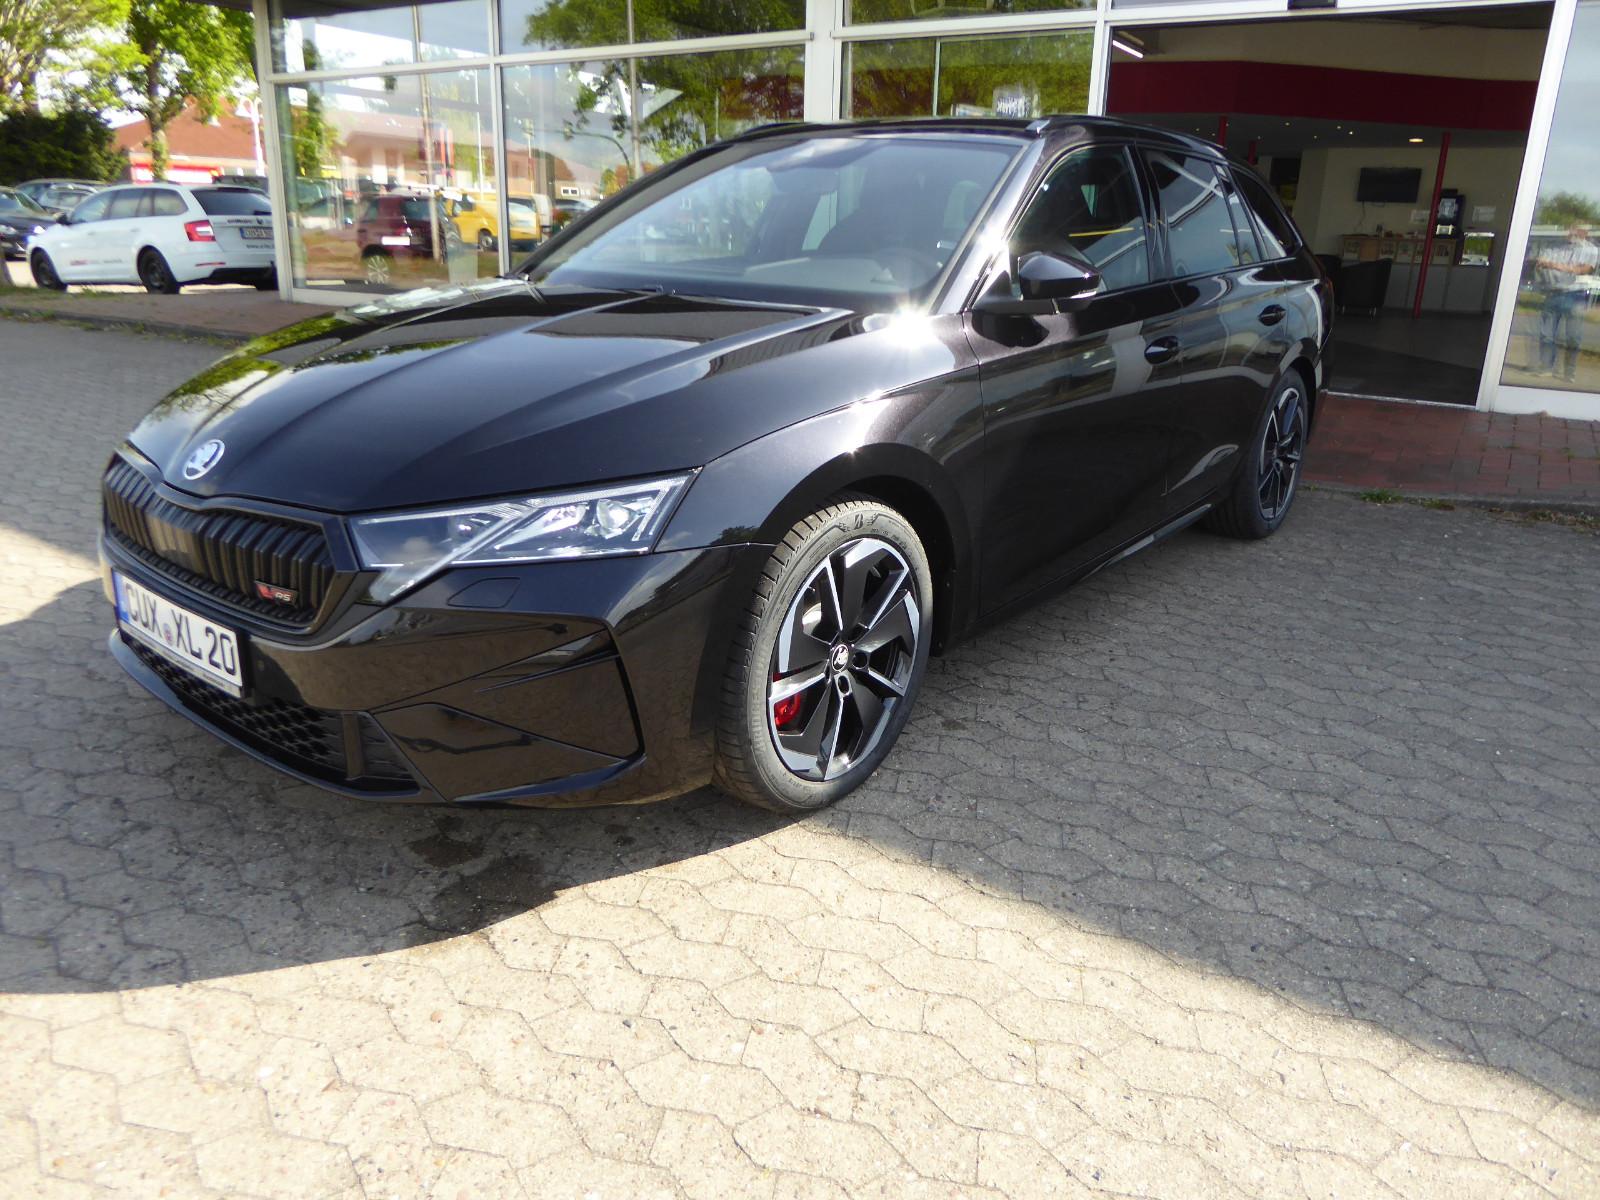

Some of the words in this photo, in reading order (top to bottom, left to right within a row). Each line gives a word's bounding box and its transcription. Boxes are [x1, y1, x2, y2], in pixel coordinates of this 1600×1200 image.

[126, 583, 162, 638] CUX
[171, 609, 203, 660] XL
[205, 626, 236, 676] 20
